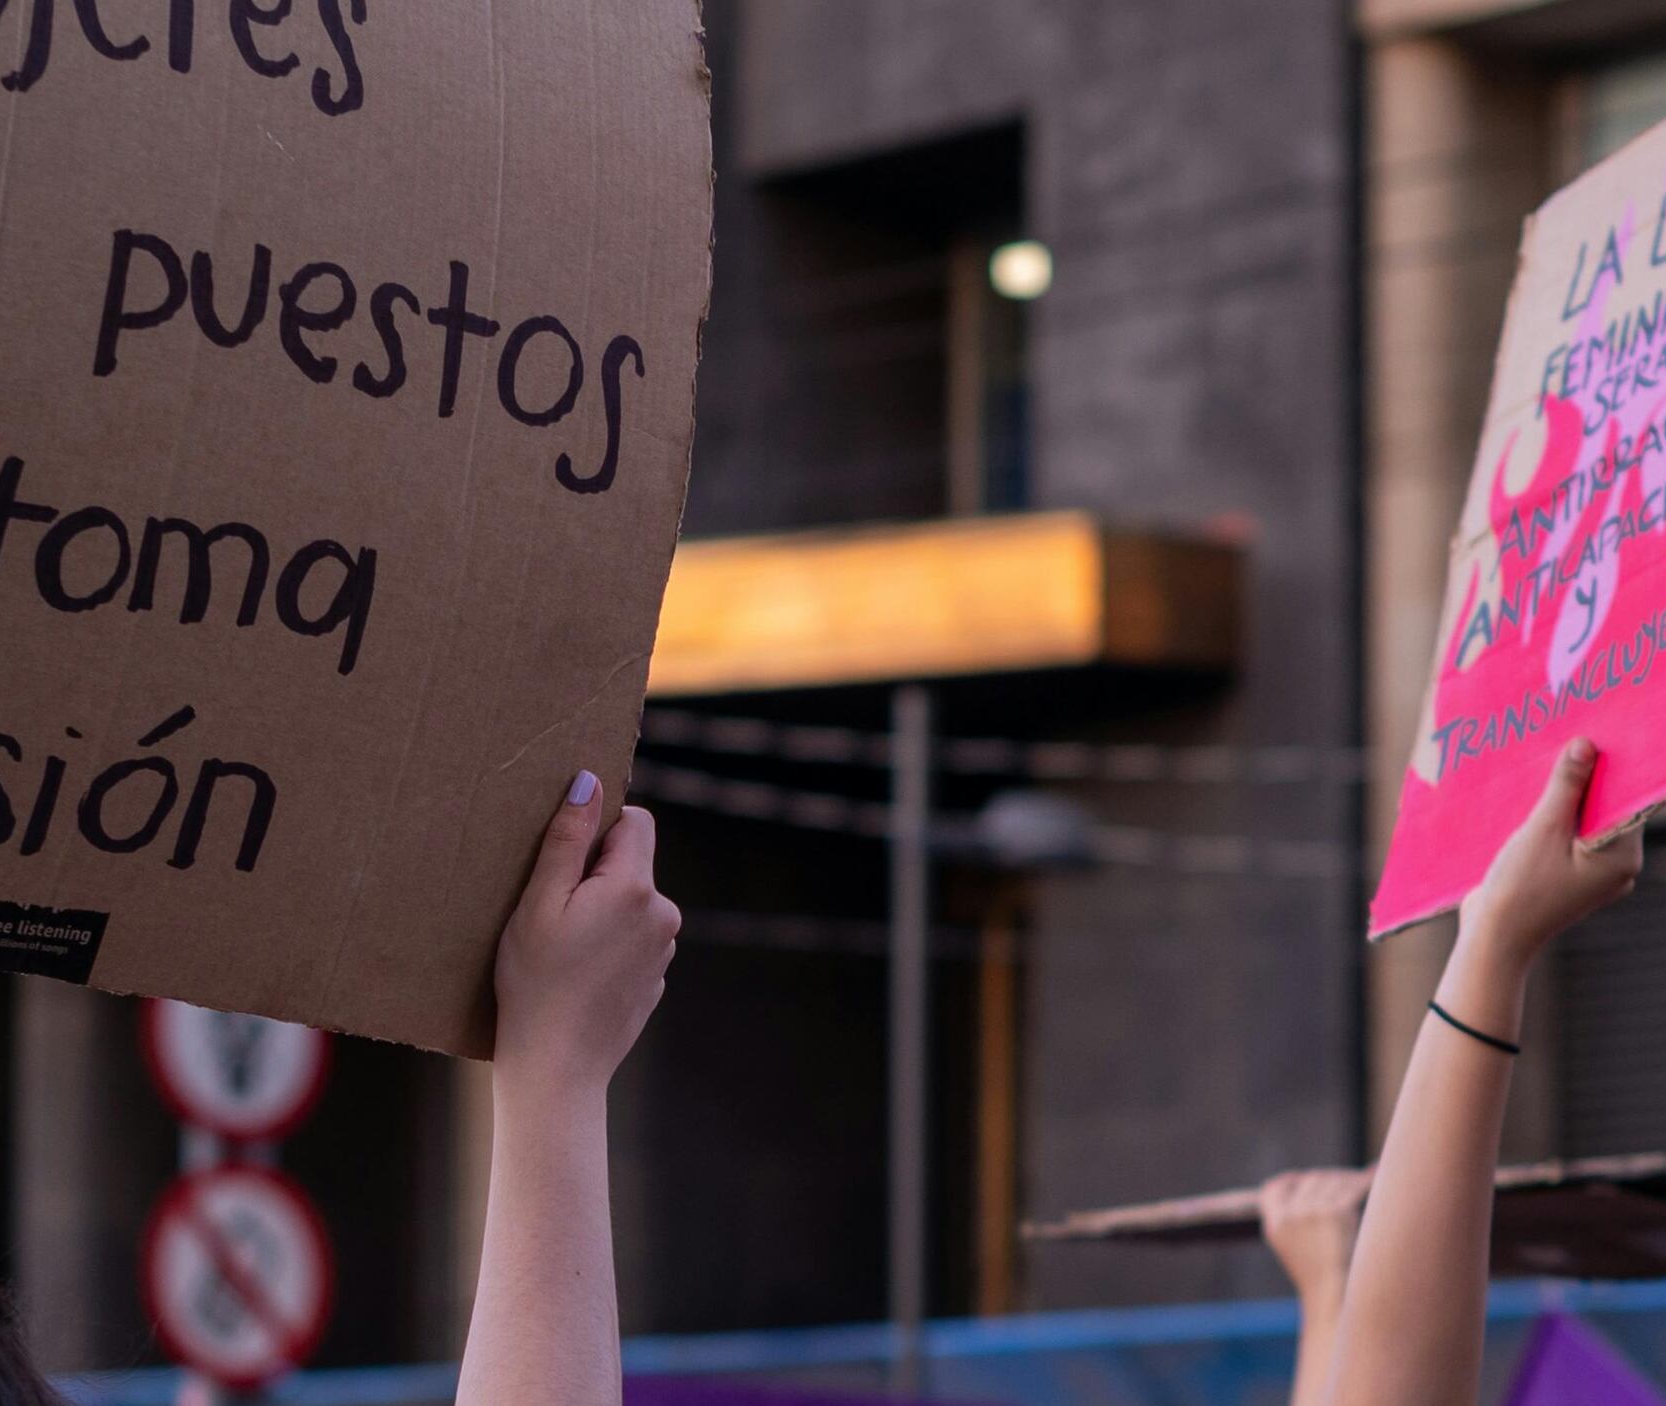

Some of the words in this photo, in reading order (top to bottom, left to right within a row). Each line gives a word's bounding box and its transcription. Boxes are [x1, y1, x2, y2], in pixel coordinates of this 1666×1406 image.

[1561, 225, 1623, 322] LA
[93, 229, 646, 495] puestos
[17, 920, 92, 945] listening
